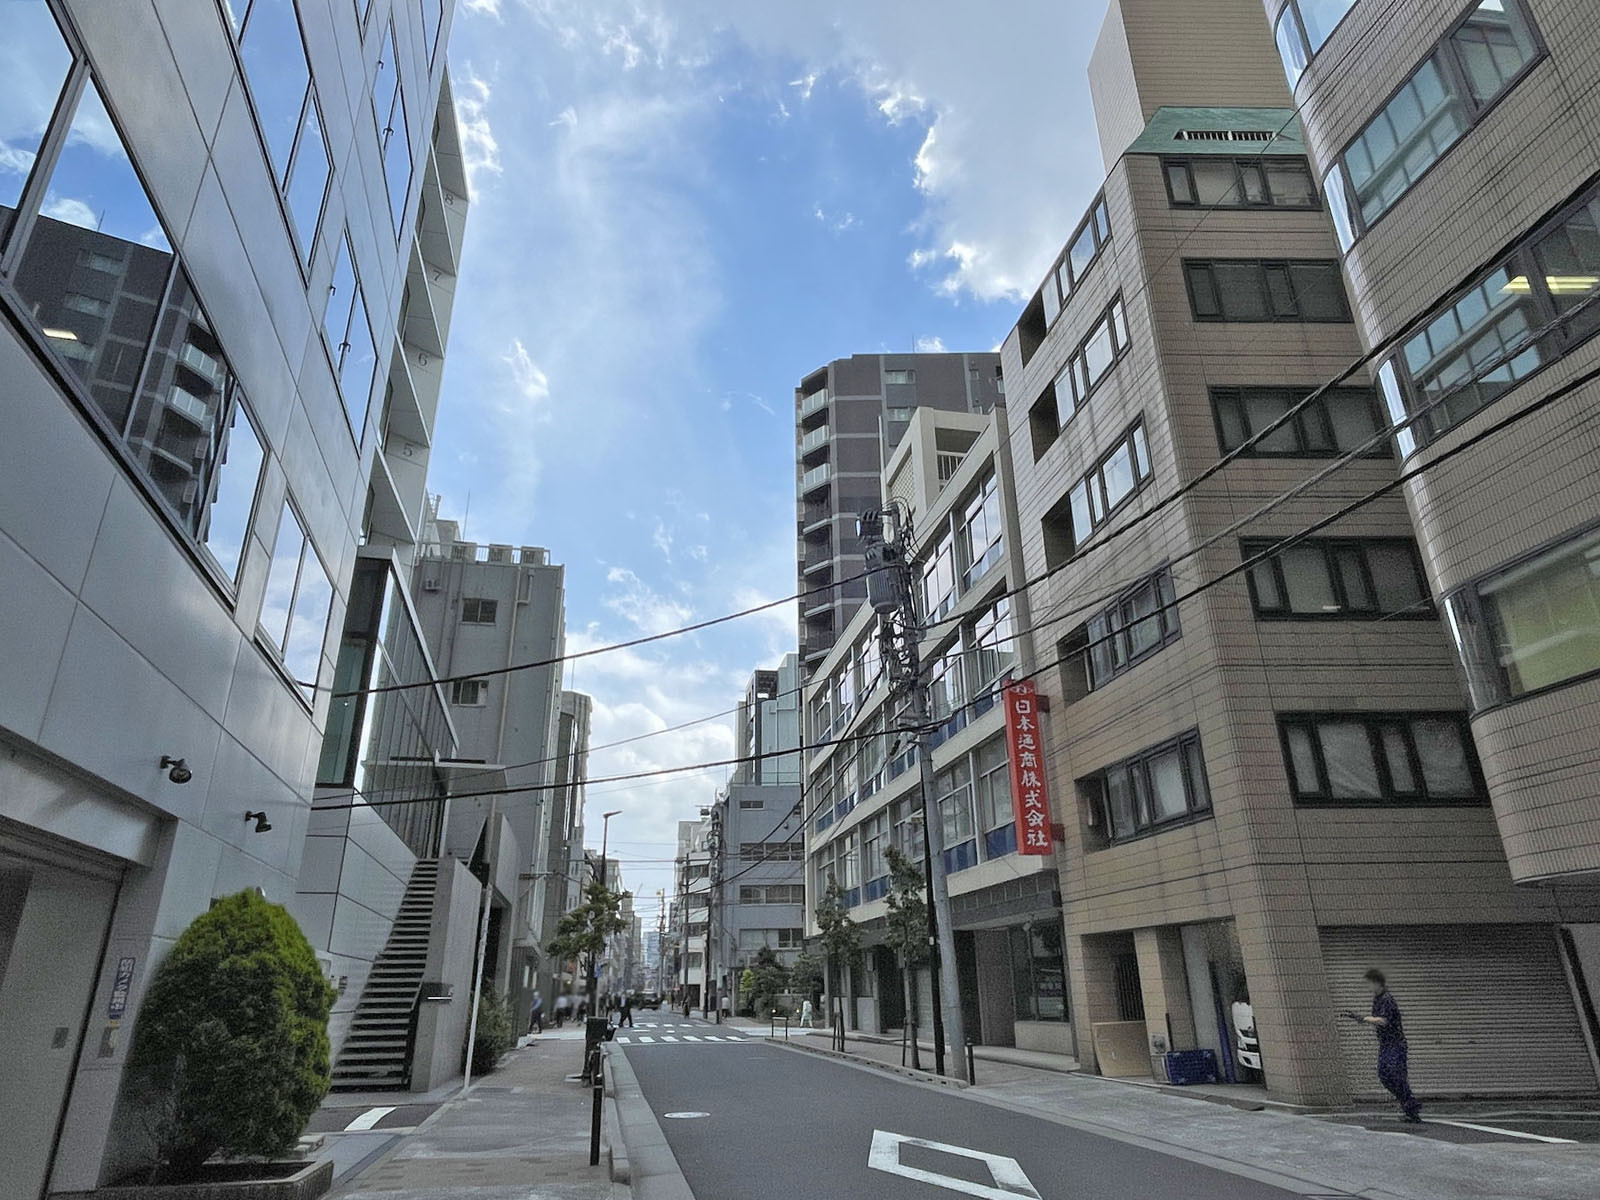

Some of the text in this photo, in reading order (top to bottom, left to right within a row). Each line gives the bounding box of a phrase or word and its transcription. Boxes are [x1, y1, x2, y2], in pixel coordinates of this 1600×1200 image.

[445, 194, 454, 206] 8
[433, 269, 442, 281] 7
[418, 352, 428, 367] 6
[403, 442, 413, 457] 5
[1015, 700, 1049, 848] 日本通商株式会社
